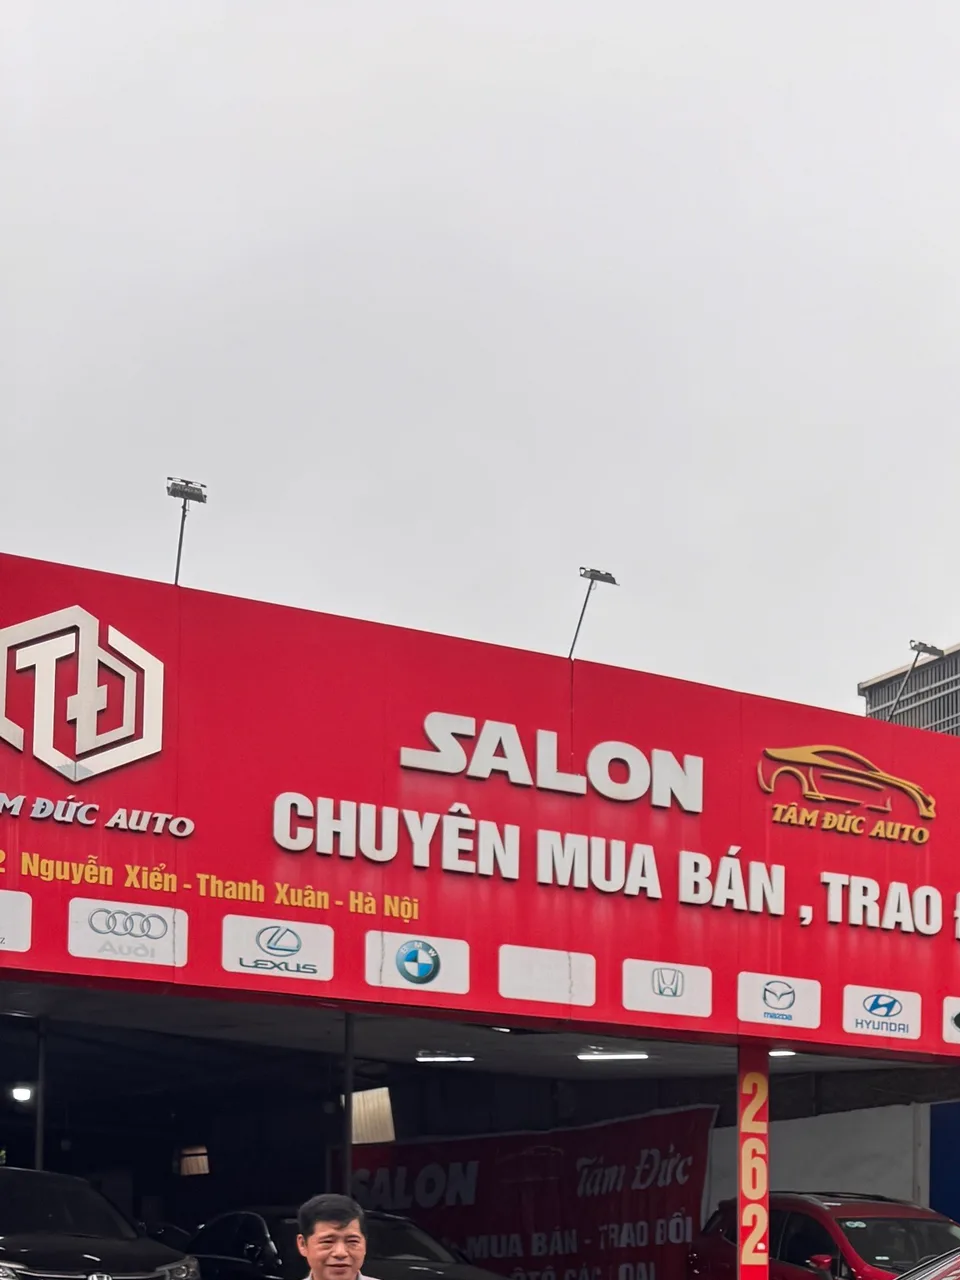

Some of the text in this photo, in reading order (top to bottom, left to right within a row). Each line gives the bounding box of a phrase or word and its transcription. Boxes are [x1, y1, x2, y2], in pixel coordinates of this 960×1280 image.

[400, 711, 704, 813] SALON
[30, 795, 100, 825] ĐỨC
[104, 808, 195, 837] AUTO
[772, 802, 930, 844] TÂM ĐỨC AUTO
[273, 791, 520, 880] CHUYÊN
[536, 829, 662, 899] MUA
[679, 845, 785, 917] BÁN
[21, 852, 113, 885] Nguyễn
[124, 863, 177, 893] Xiển
[196, 873, 265, 903] Thanh
[275, 882, 330, 910] Xuân
[349, 890, 376, 915] Hà
[384, 895, 419, 923] Nội
[97, 940, 156, 959] Audi
[239, 957, 318, 974] LEXUS
[855, 1018, 909, 1034] HYUNDAI
[351, 1160, 479, 1211] SALON
[741, 1072, 769, 1265] 262
[465, 1232, 524, 1259] MUA
[531, 1225, 578, 1256] BÁN
